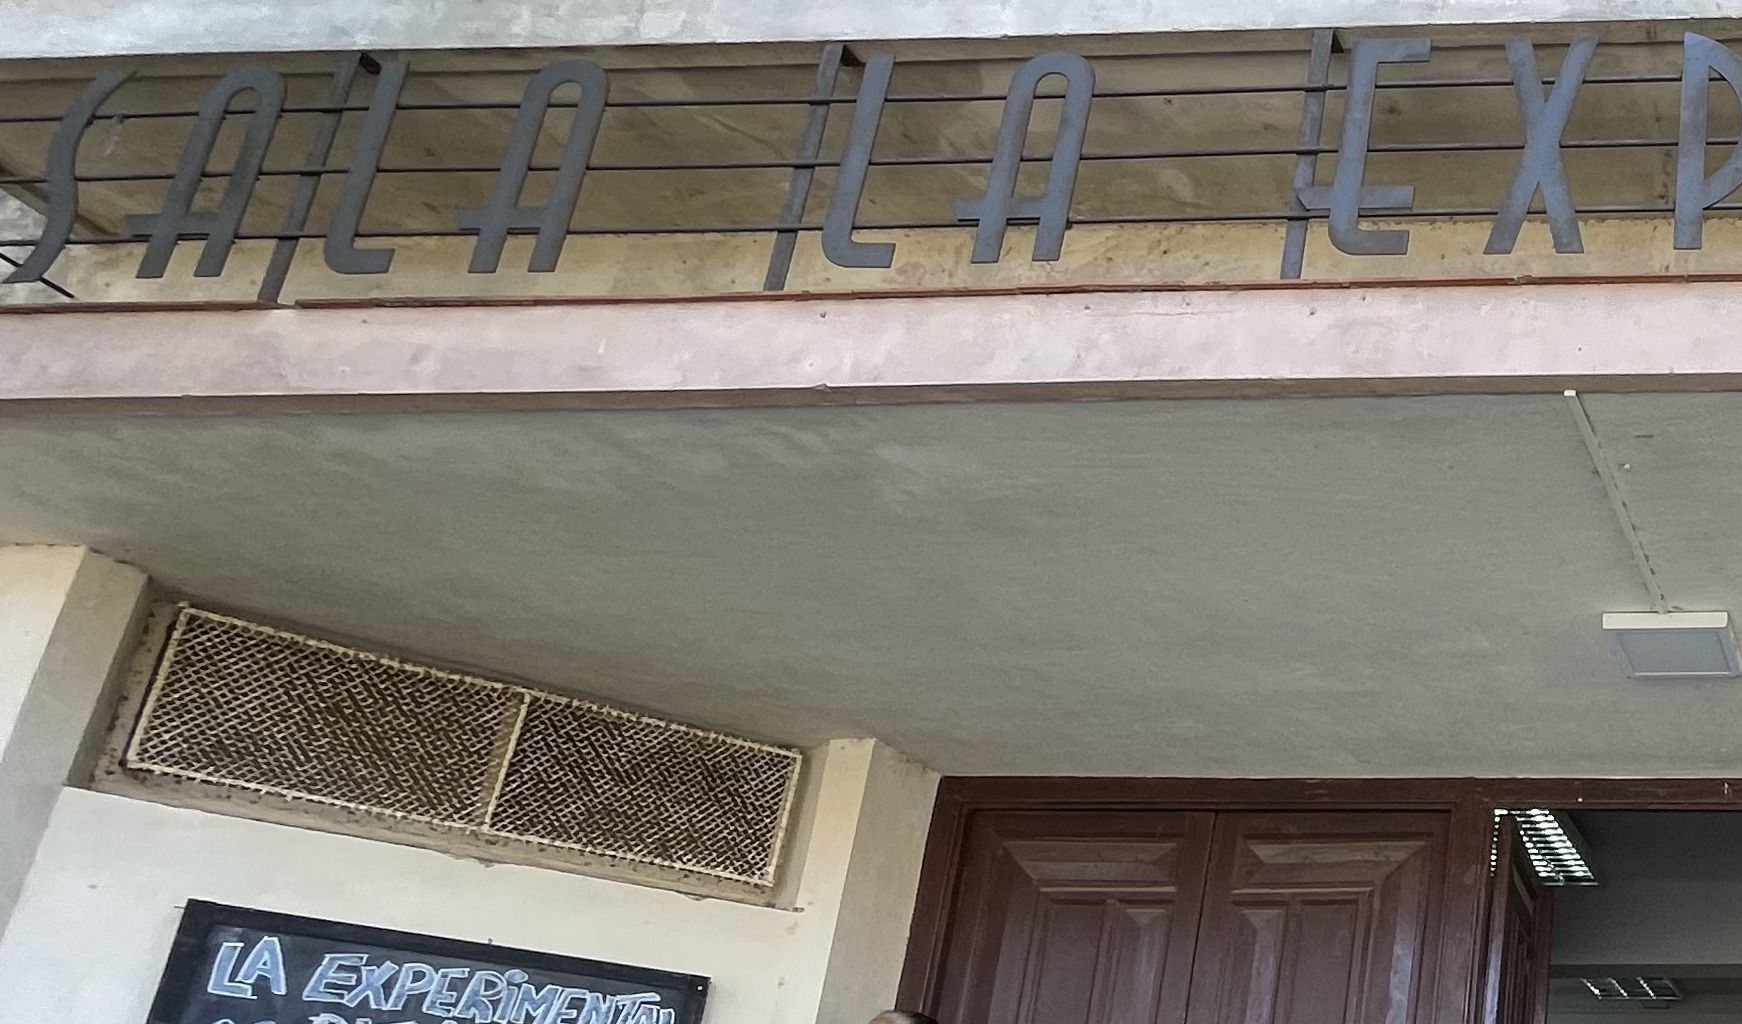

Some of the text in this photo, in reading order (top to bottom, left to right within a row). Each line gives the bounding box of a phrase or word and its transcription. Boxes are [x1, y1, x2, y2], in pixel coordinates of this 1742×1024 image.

[2, 56, 610, 285] SALA
[819, 50, 1097, 268] LA
[206, 936, 287, 1000] LA
